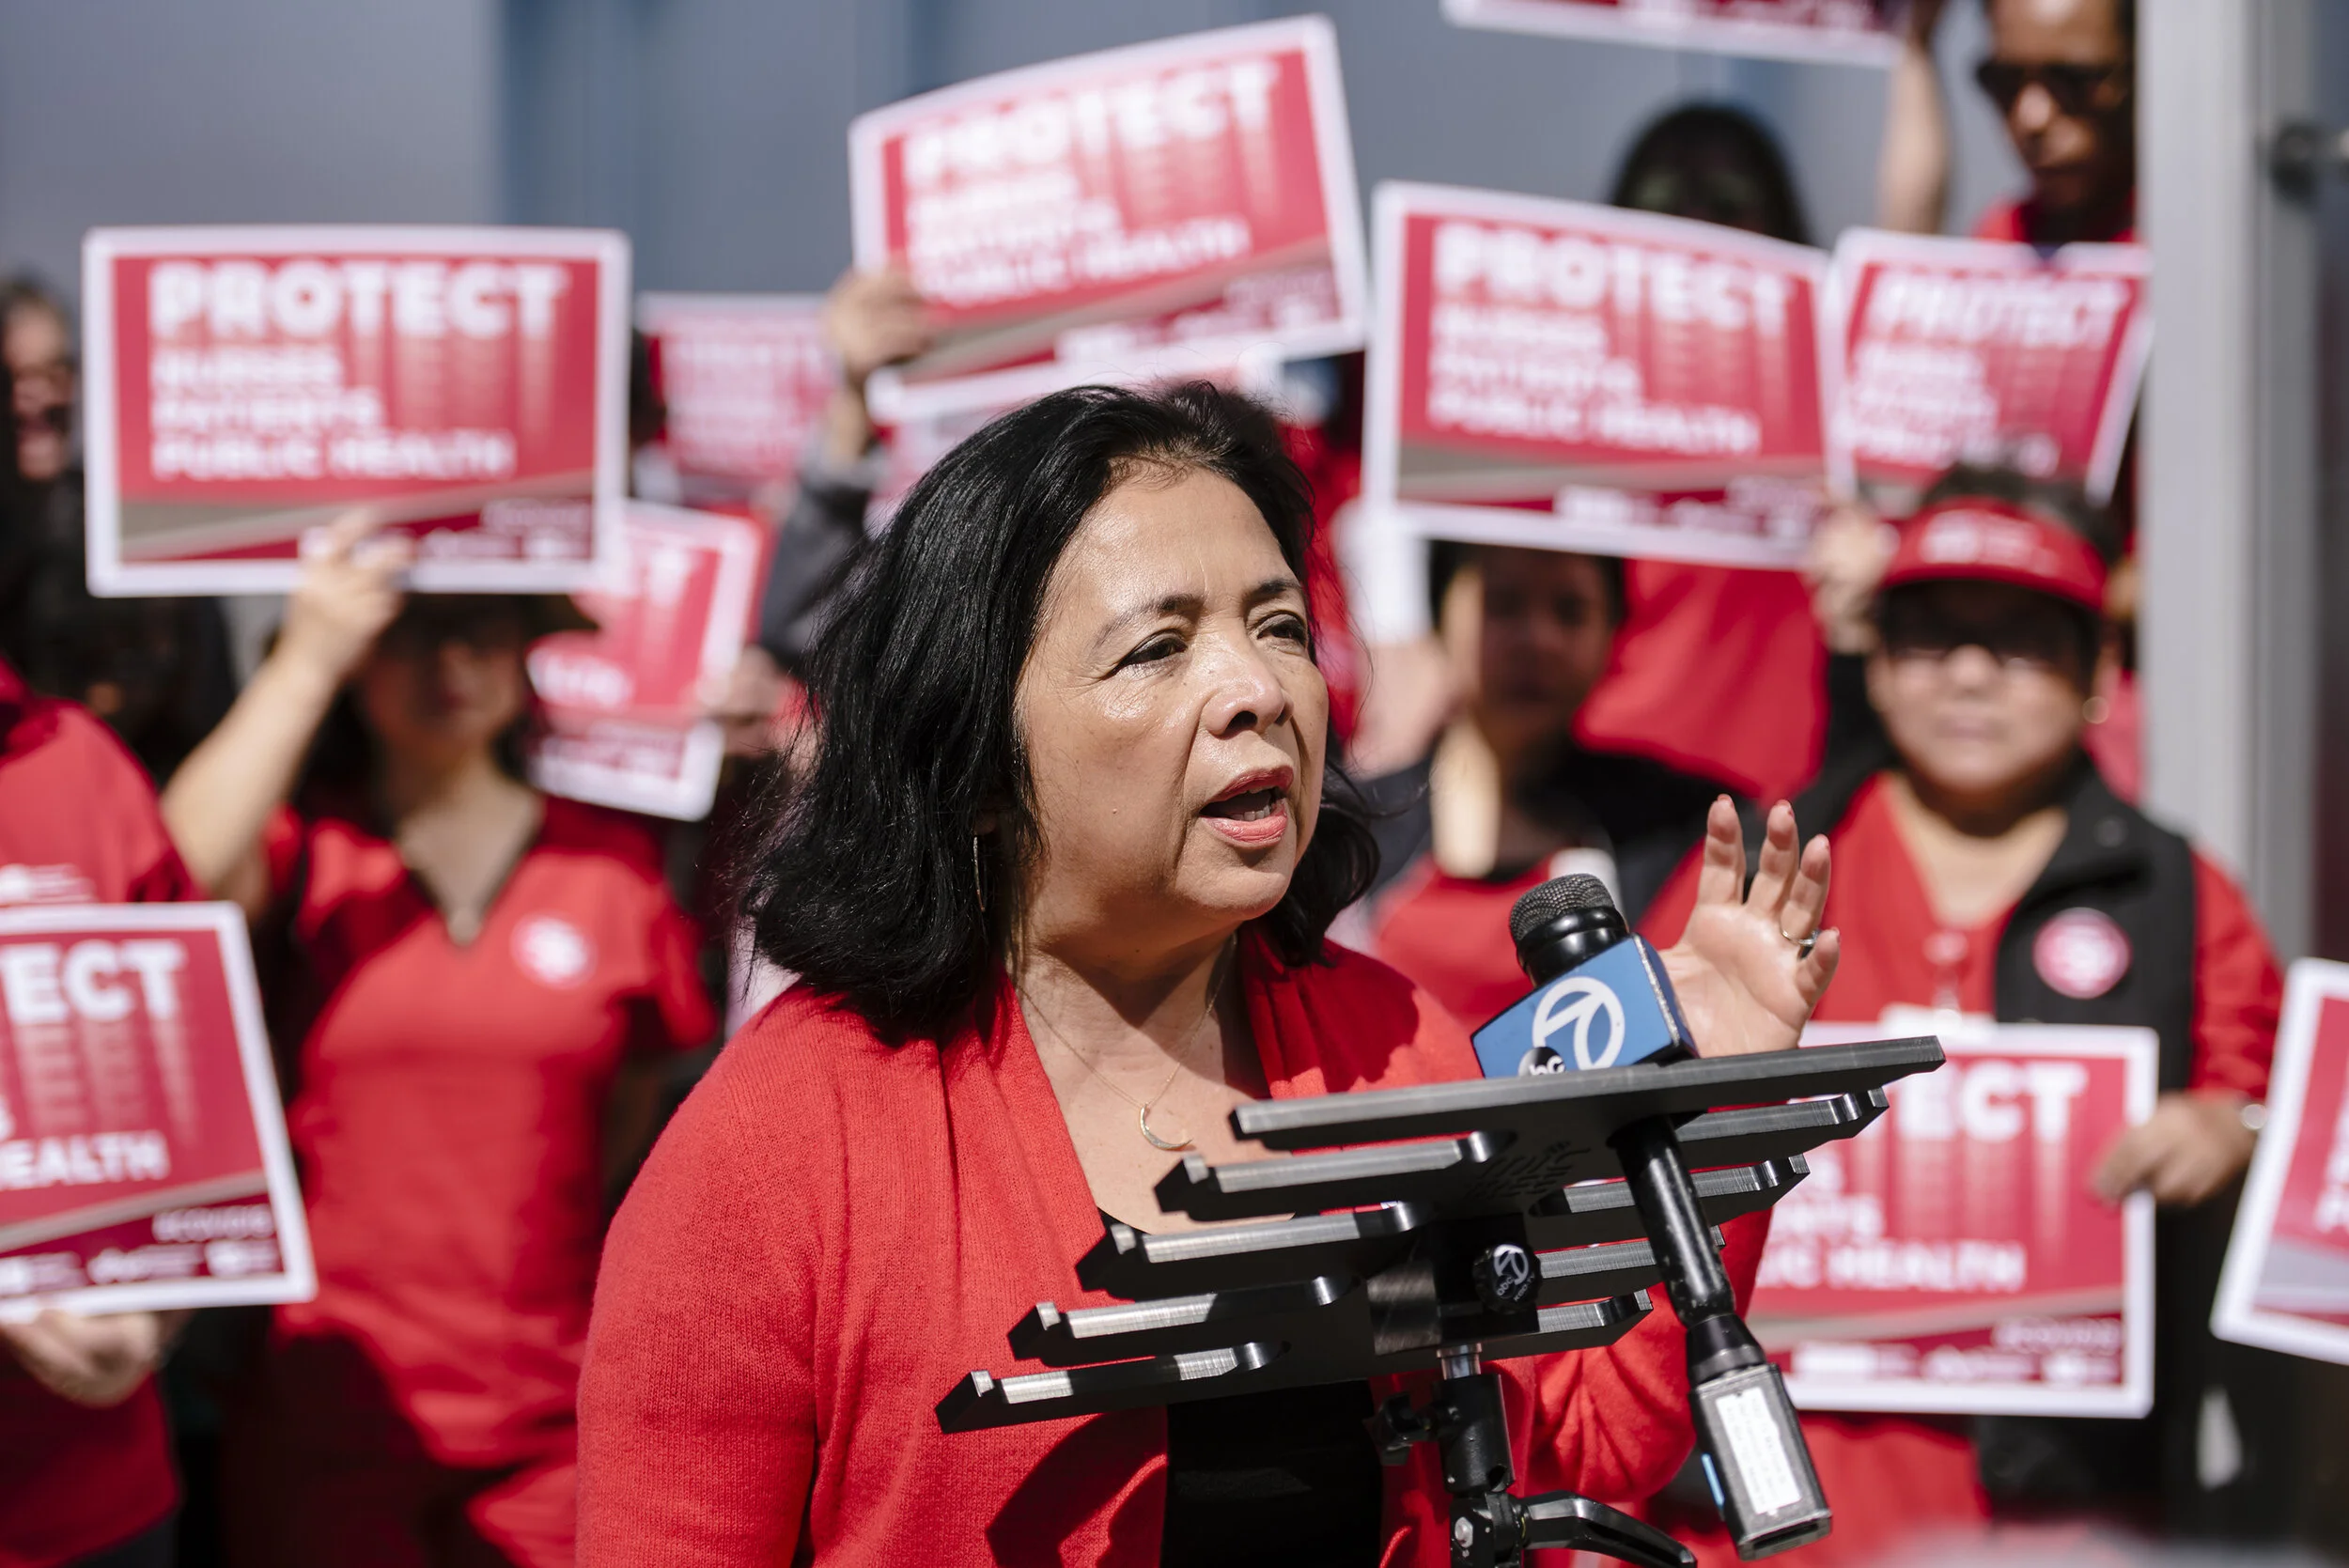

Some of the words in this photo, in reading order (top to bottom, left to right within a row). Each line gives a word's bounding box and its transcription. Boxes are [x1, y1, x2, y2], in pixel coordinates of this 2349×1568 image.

[908, 62, 1281, 173] PROTECT
[150, 262, 562, 337] PROTECT
[1434, 223, 1796, 333] PROTECT
[153, 437, 320, 477] PUBLIC
[330, 430, 515, 477] HEALTH
[1890, 1060, 2088, 1141] ECT
